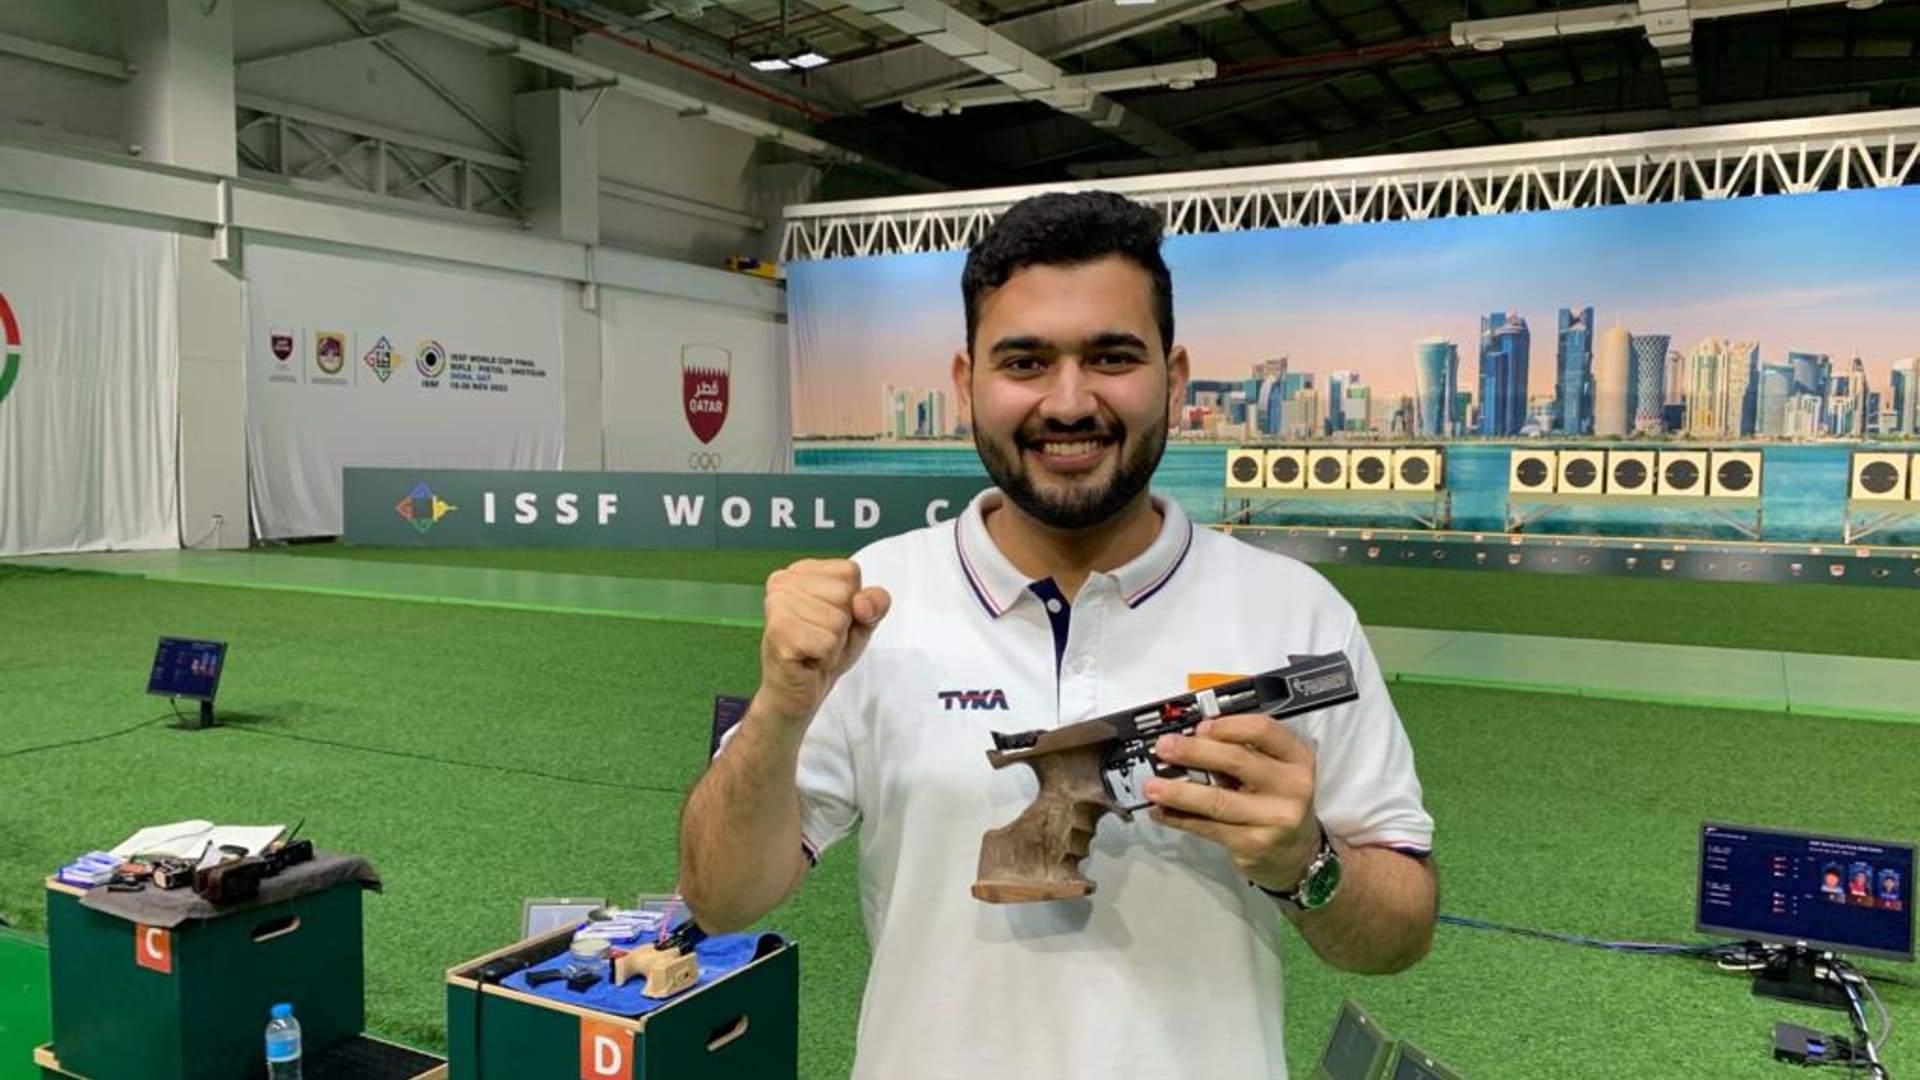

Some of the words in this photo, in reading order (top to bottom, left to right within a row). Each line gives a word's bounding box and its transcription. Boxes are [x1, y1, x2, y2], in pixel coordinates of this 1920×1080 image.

[694, 380, 719, 398] قطر
[689, 398, 723, 413] QATAR
[483, 492, 619, 526] ISSF
[663, 495, 881, 527] WORLD
[938, 688, 1010, 711] TYKA
[144, 926, 163, 960] C
[593, 1035, 622, 1076] D
